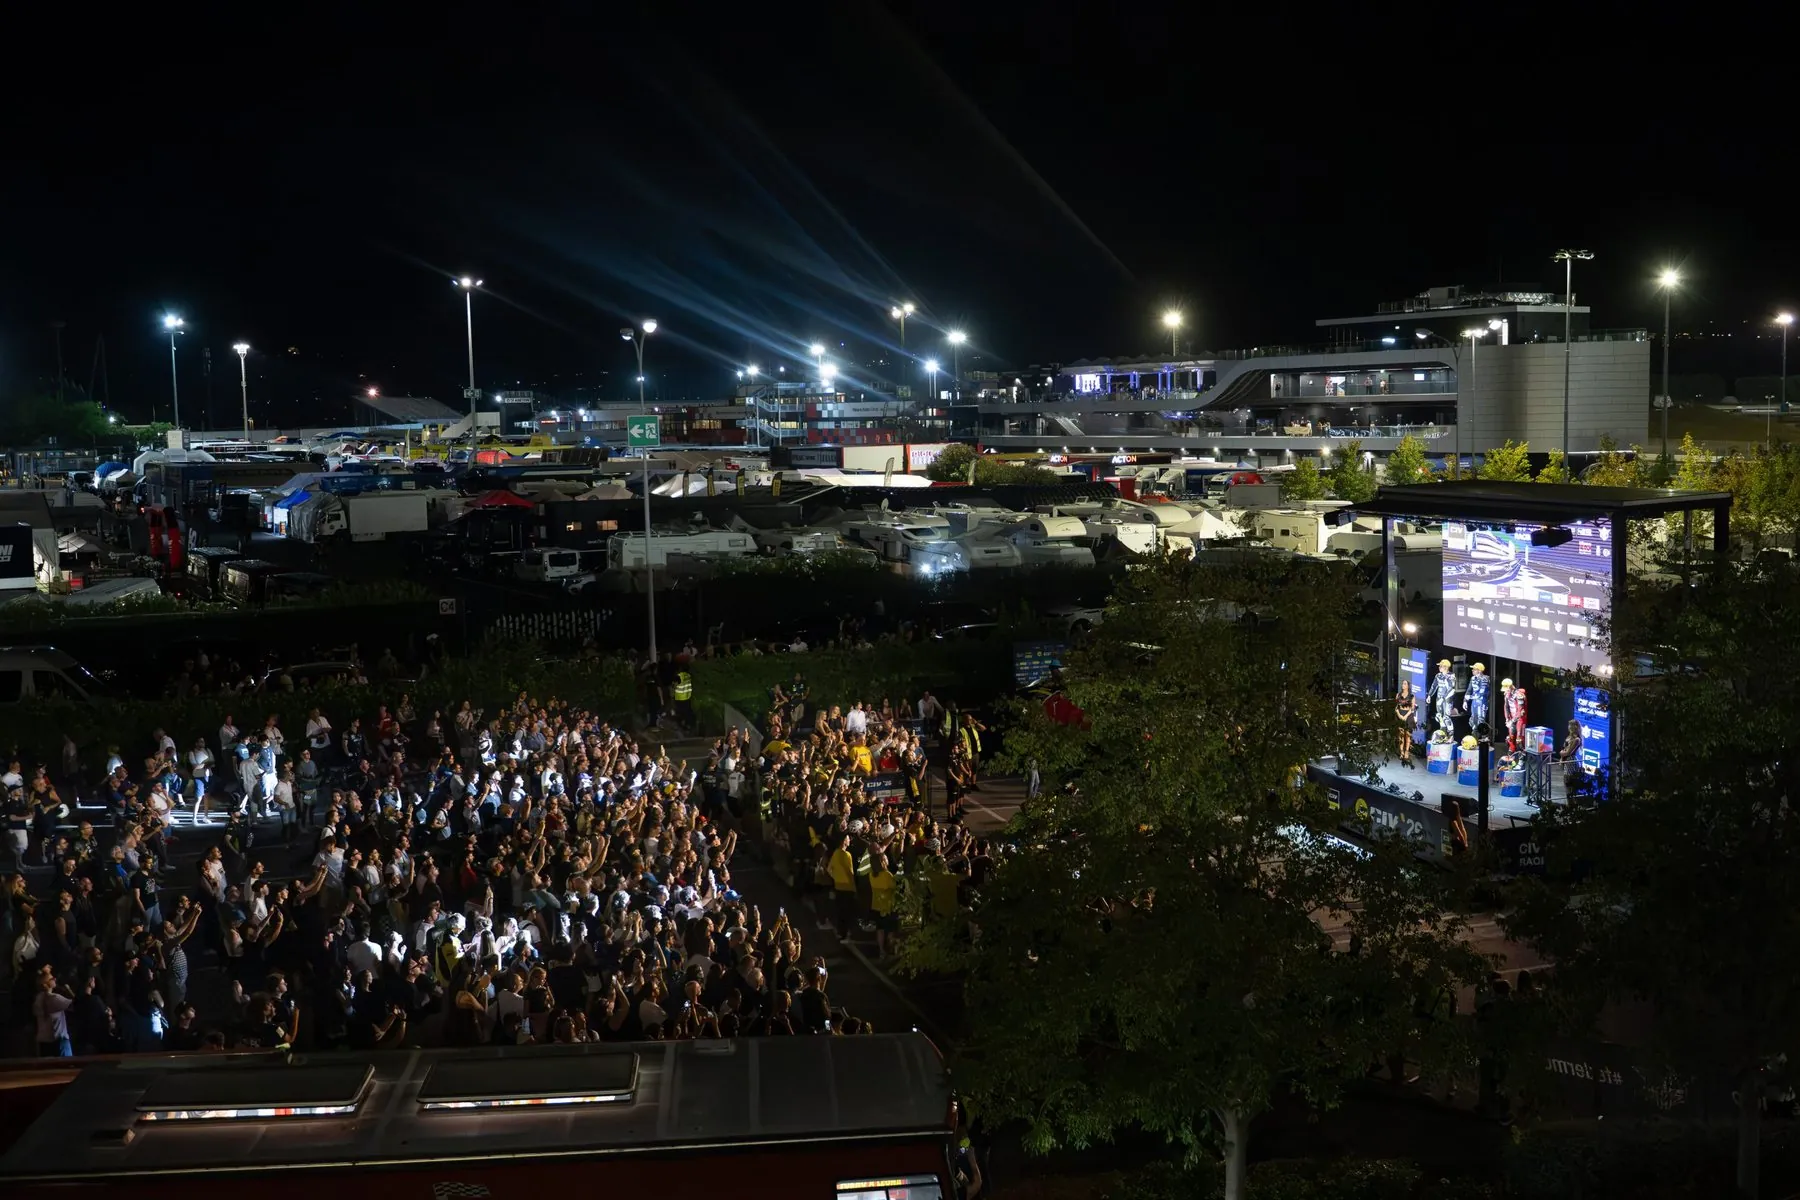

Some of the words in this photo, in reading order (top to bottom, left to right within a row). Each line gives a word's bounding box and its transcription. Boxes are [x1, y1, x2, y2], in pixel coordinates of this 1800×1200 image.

[1050, 455, 1068, 463] ACTON
[1111, 455, 1137, 464] ACTON
[1369, 806, 1399, 829] CIV
[1519, 842, 1541, 855] CIV
[1519, 856, 1545, 867] RACI
